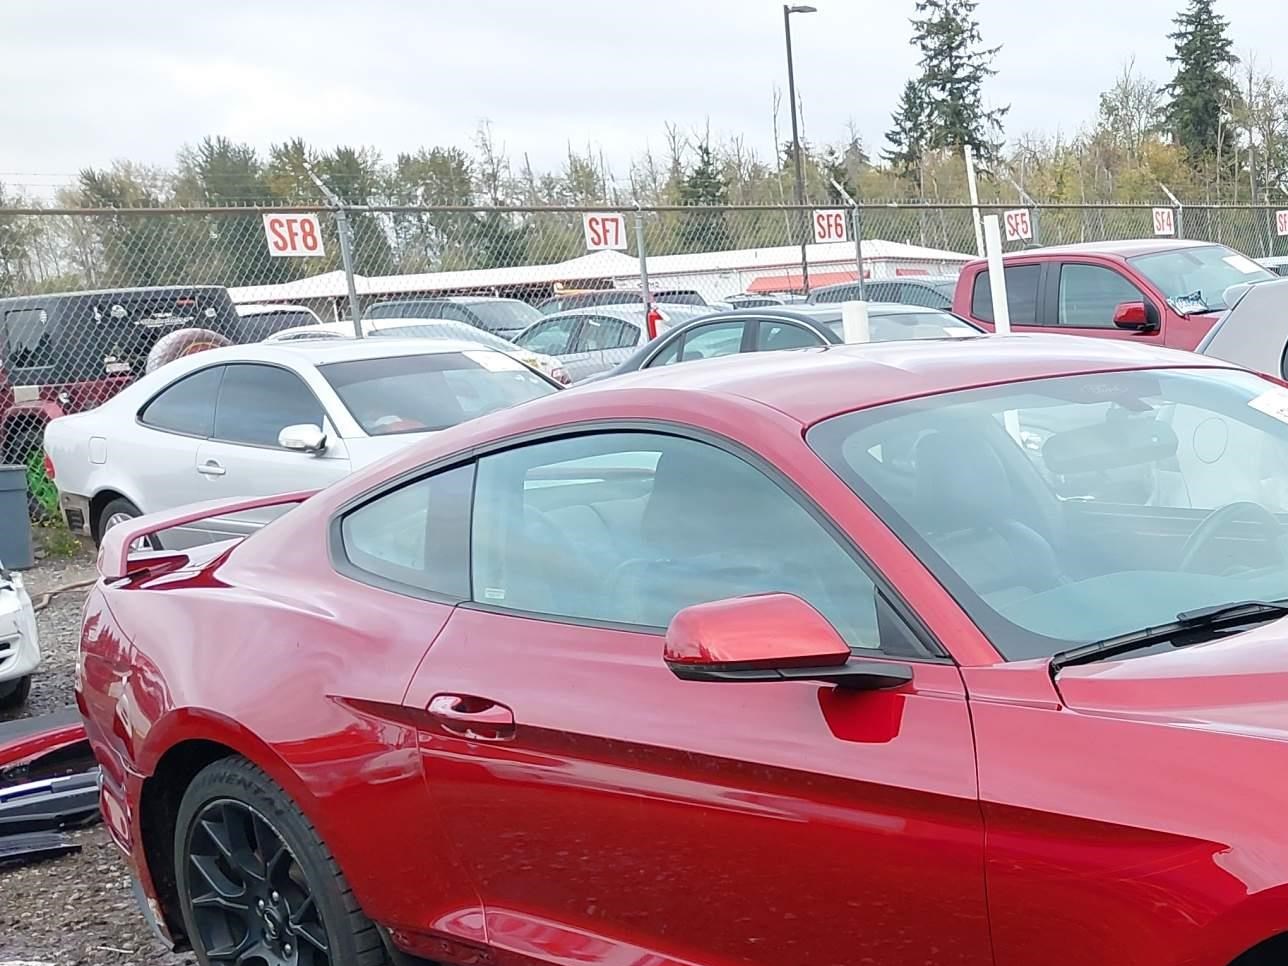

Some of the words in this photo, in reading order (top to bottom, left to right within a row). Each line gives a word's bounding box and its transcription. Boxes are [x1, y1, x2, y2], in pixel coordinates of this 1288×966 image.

[588, 217, 619, 246] SF7
[816, 213, 843, 239] SF6
[1007, 213, 1029, 237] SF5
[1155, 209, 1172, 232] SF4
[269, 218, 318, 251] SF8
